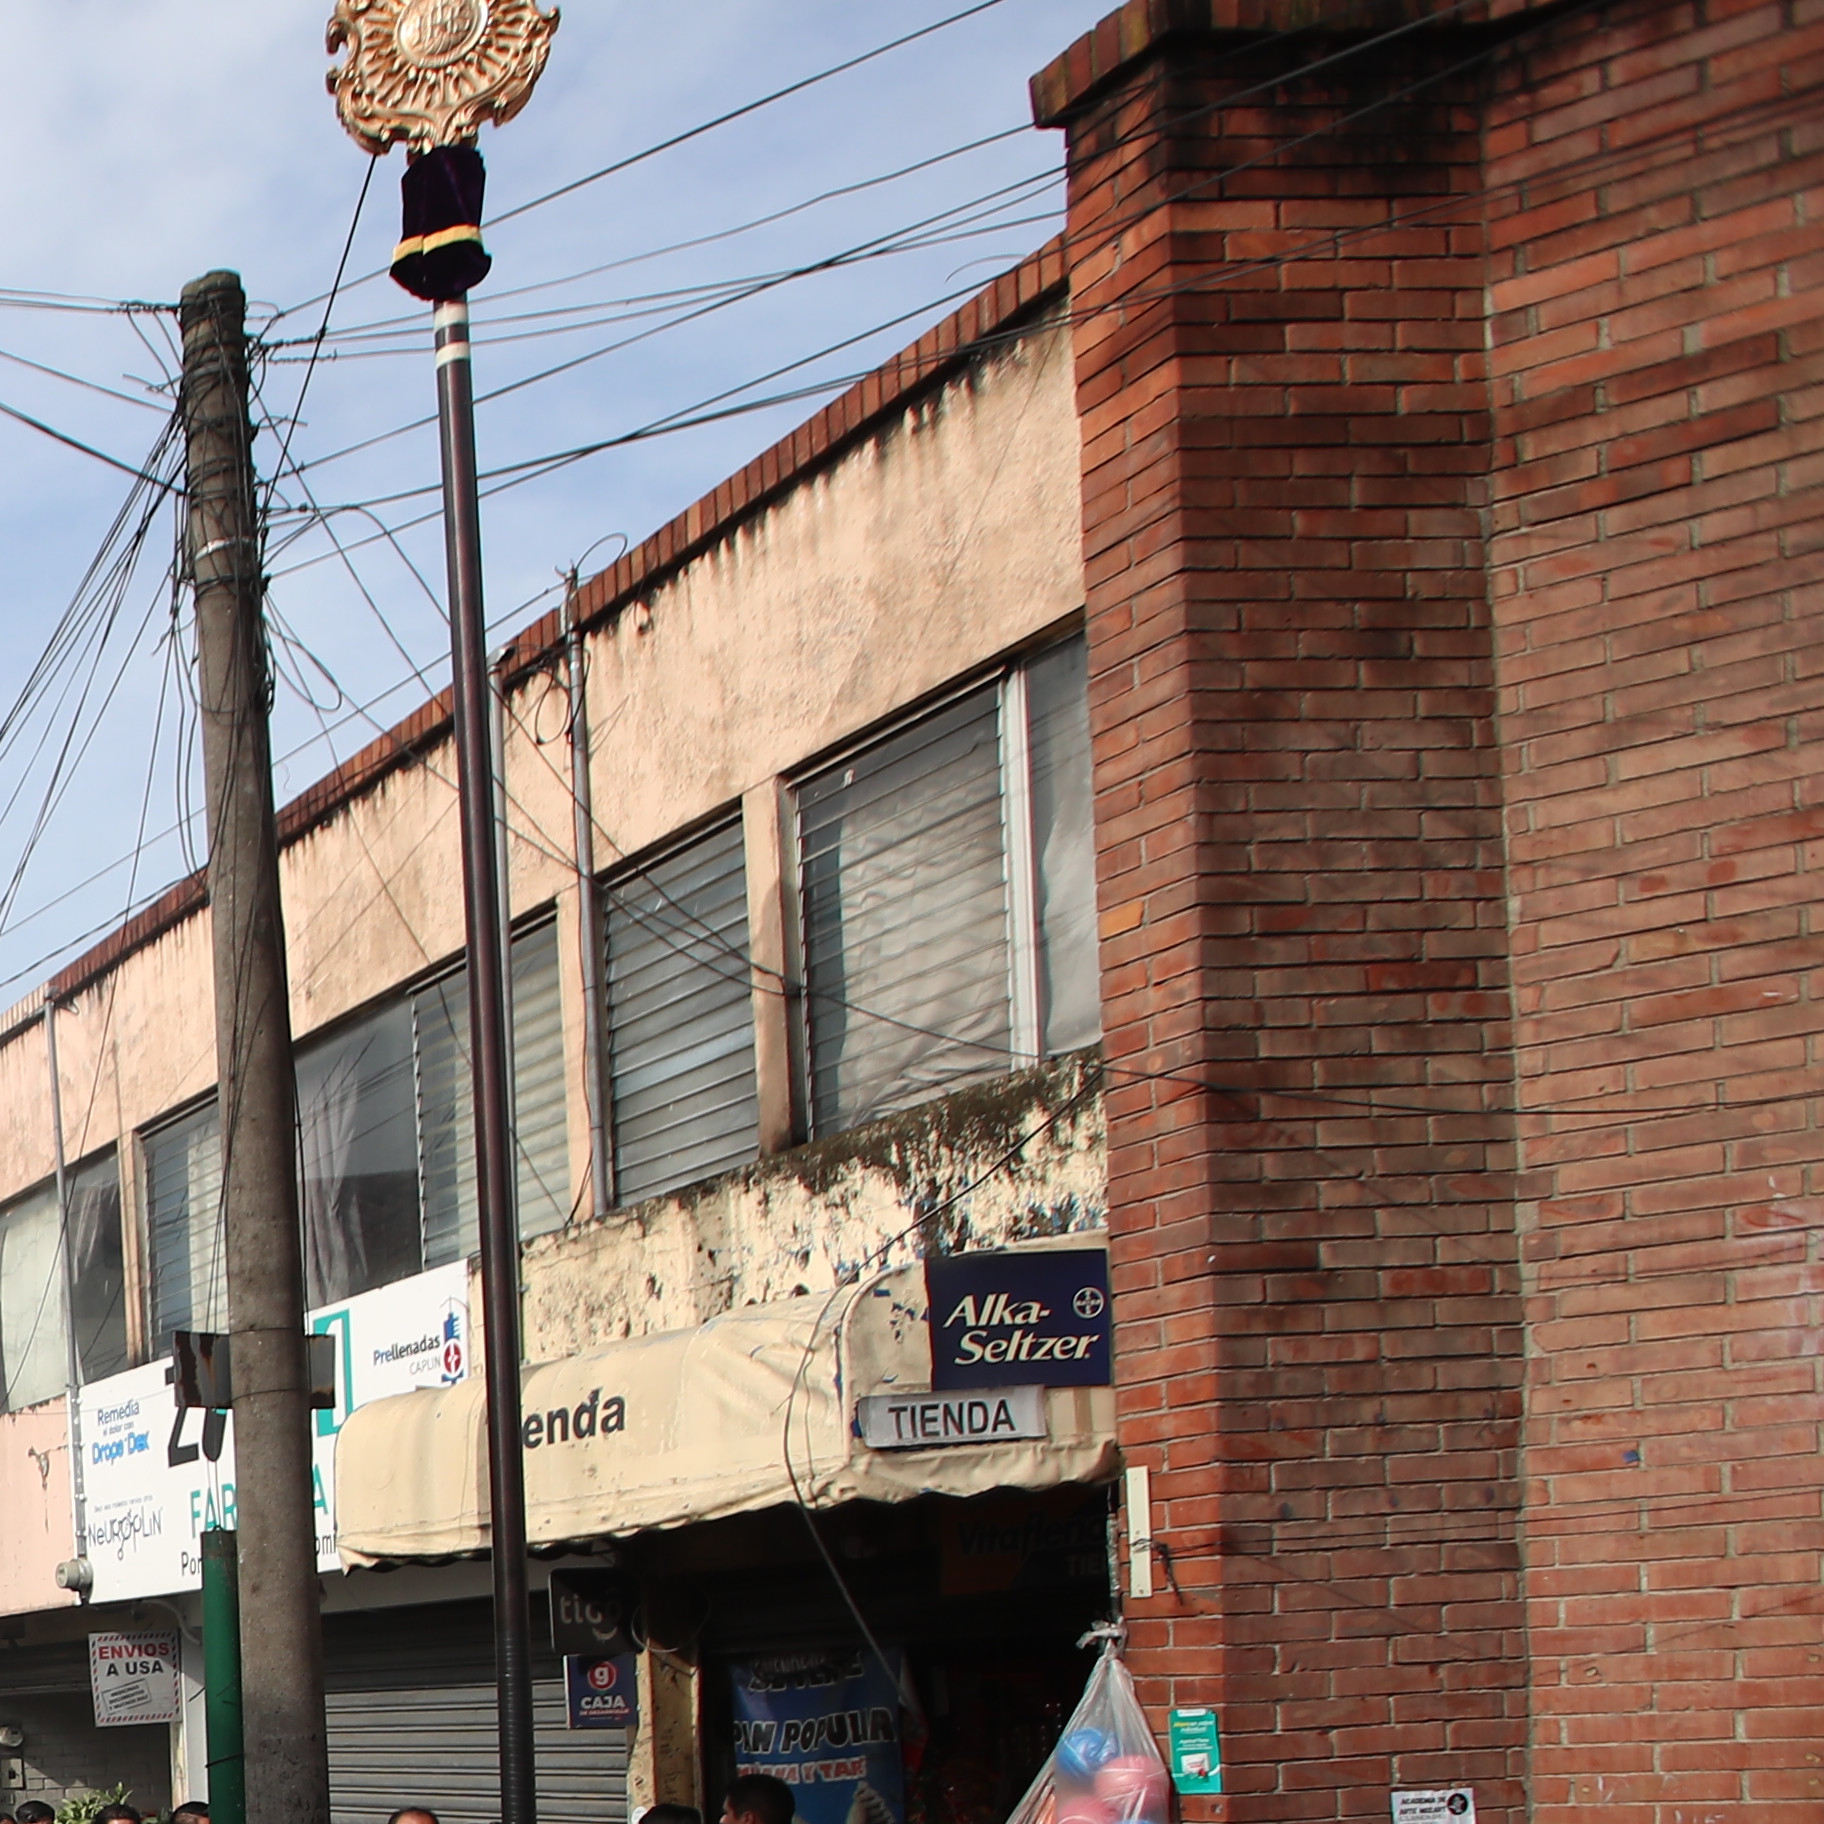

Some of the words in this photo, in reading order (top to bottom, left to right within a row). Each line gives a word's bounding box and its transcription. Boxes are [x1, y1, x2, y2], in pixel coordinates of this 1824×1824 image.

[943, 1293, 1051, 1328] Alka-
[373, 1334, 441, 1366] Prellenadas
[409, 1355, 441, 1375] CAPLIN
[97, 1399, 140, 1427] Remedia
[523, 1388, 626, 1449] enda
[888, 1399, 1016, 1440] TIENDA
[99, 1642, 170, 1660] ENVIOS
[106, 1662, 119, 1677] A
[125, 1660, 164, 1675] USA
[580, 1694, 626, 1709] CAJA
